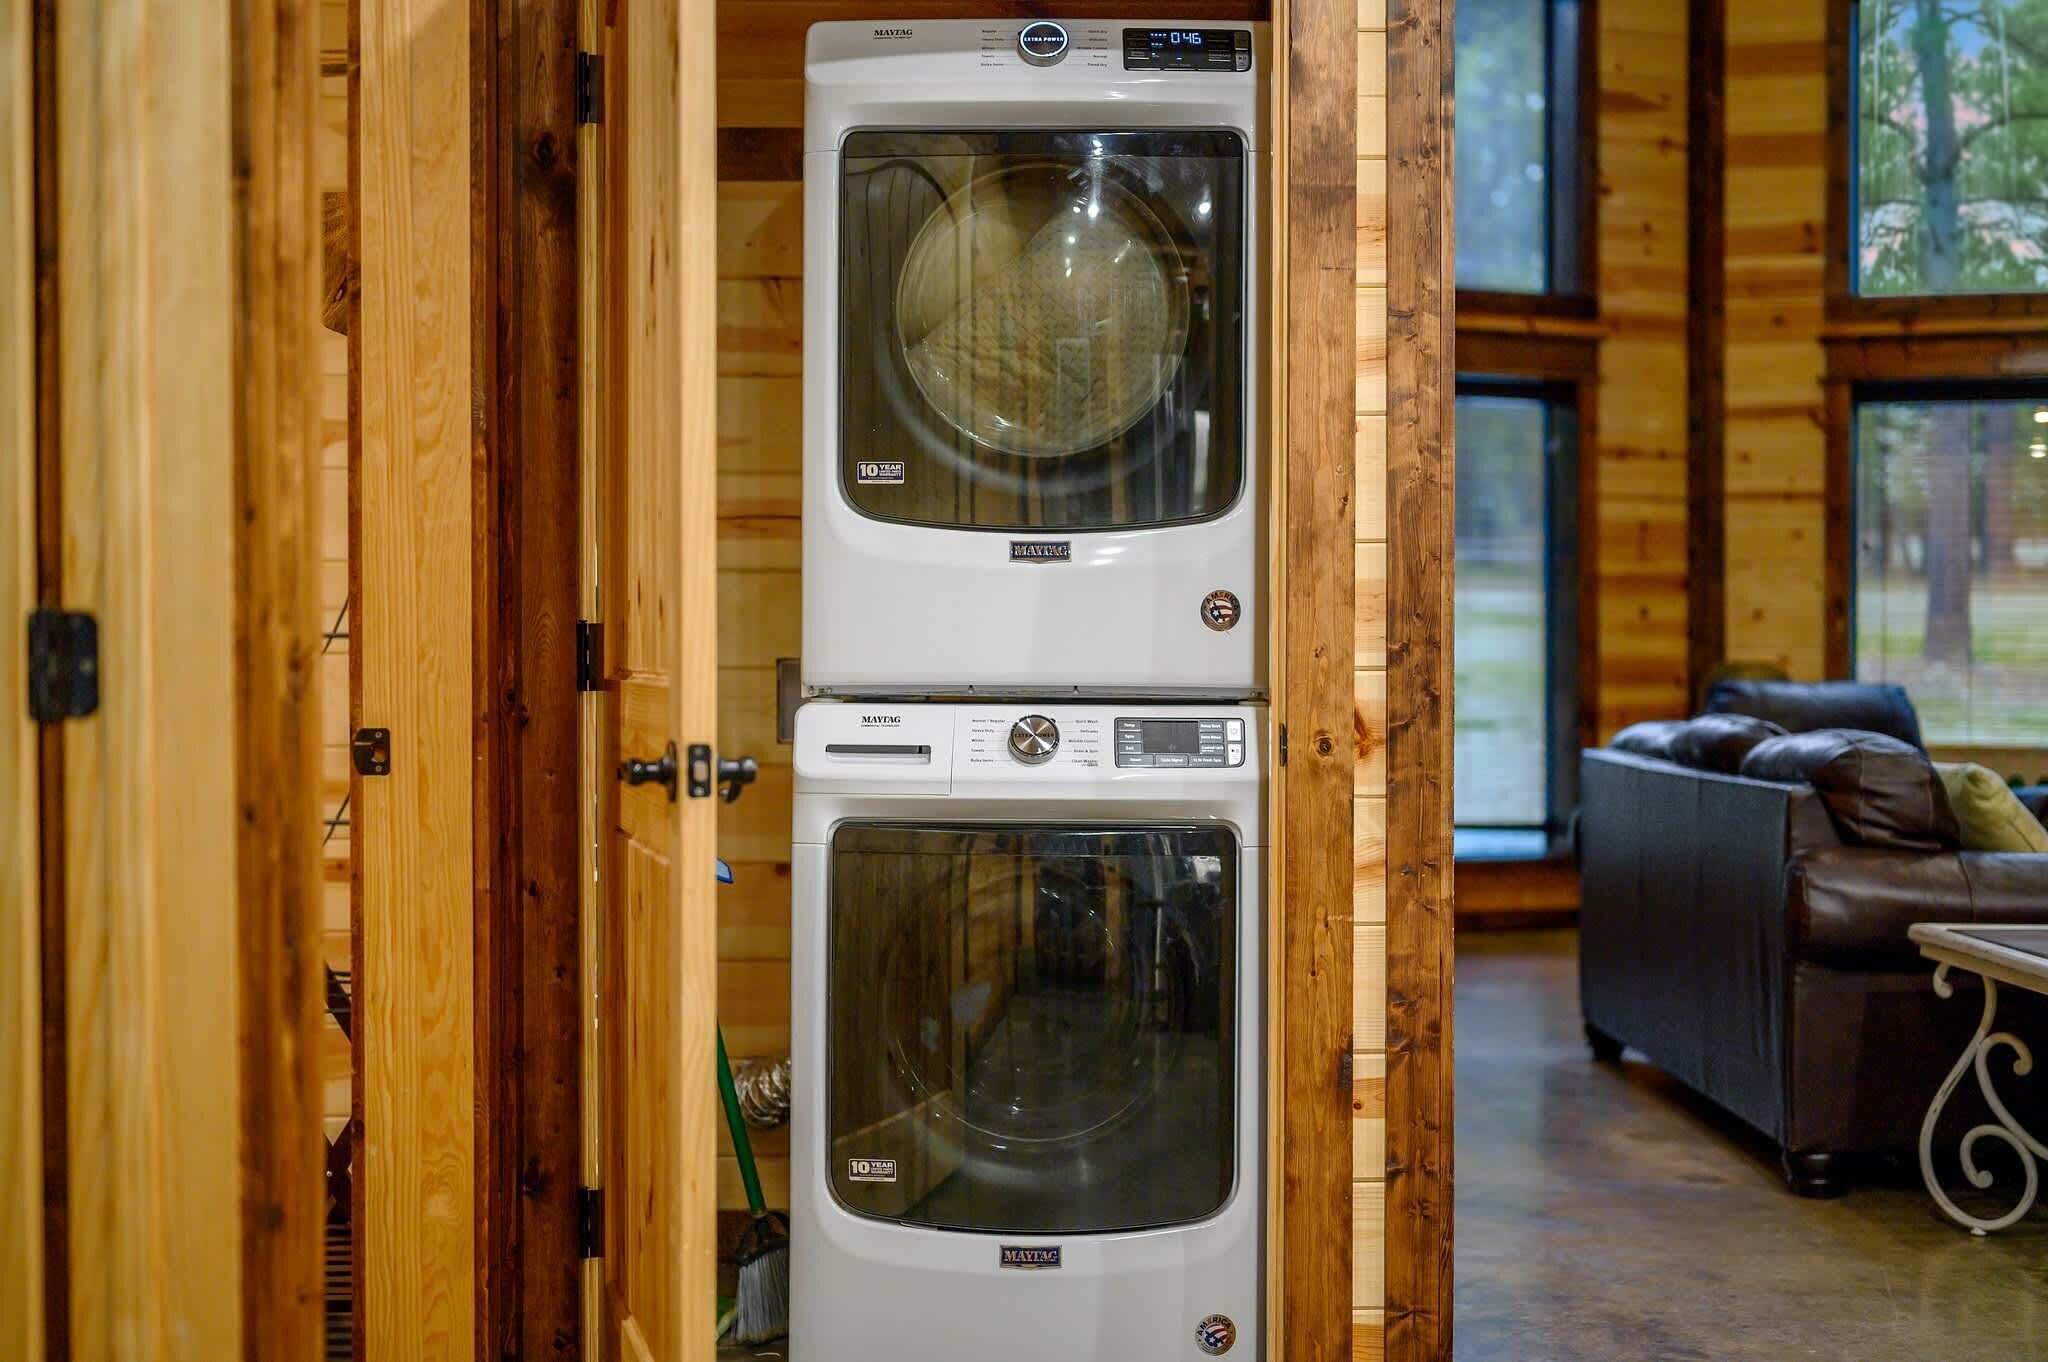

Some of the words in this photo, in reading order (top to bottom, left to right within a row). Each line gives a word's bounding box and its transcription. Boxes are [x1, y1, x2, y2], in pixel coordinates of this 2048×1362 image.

[860, 463, 879, 477] 10
[1013, 545, 1068, 556] MAYTAG
[861, 715, 902, 723] MAYTAG
[851, 1161, 870, 1174] 10
[1003, 1250, 1058, 1262] MAYTAG
